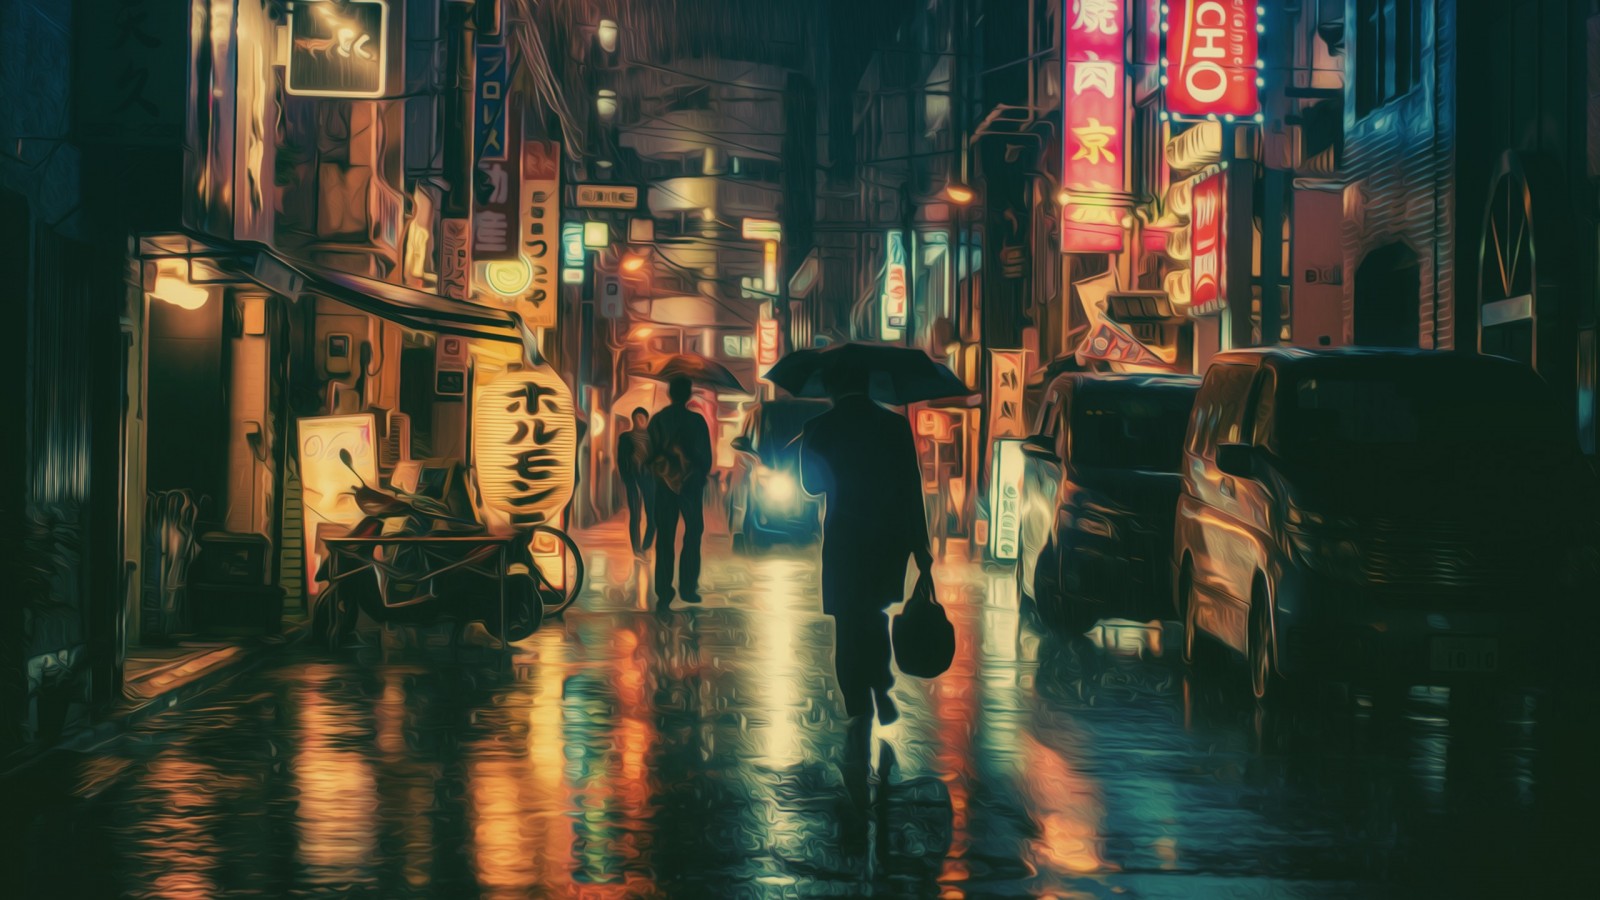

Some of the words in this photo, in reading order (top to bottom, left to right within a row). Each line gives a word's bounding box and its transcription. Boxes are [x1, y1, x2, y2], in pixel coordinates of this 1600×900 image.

[1185, 1, 1227, 103] CHO
[503, 381, 563, 506] ホルモン
